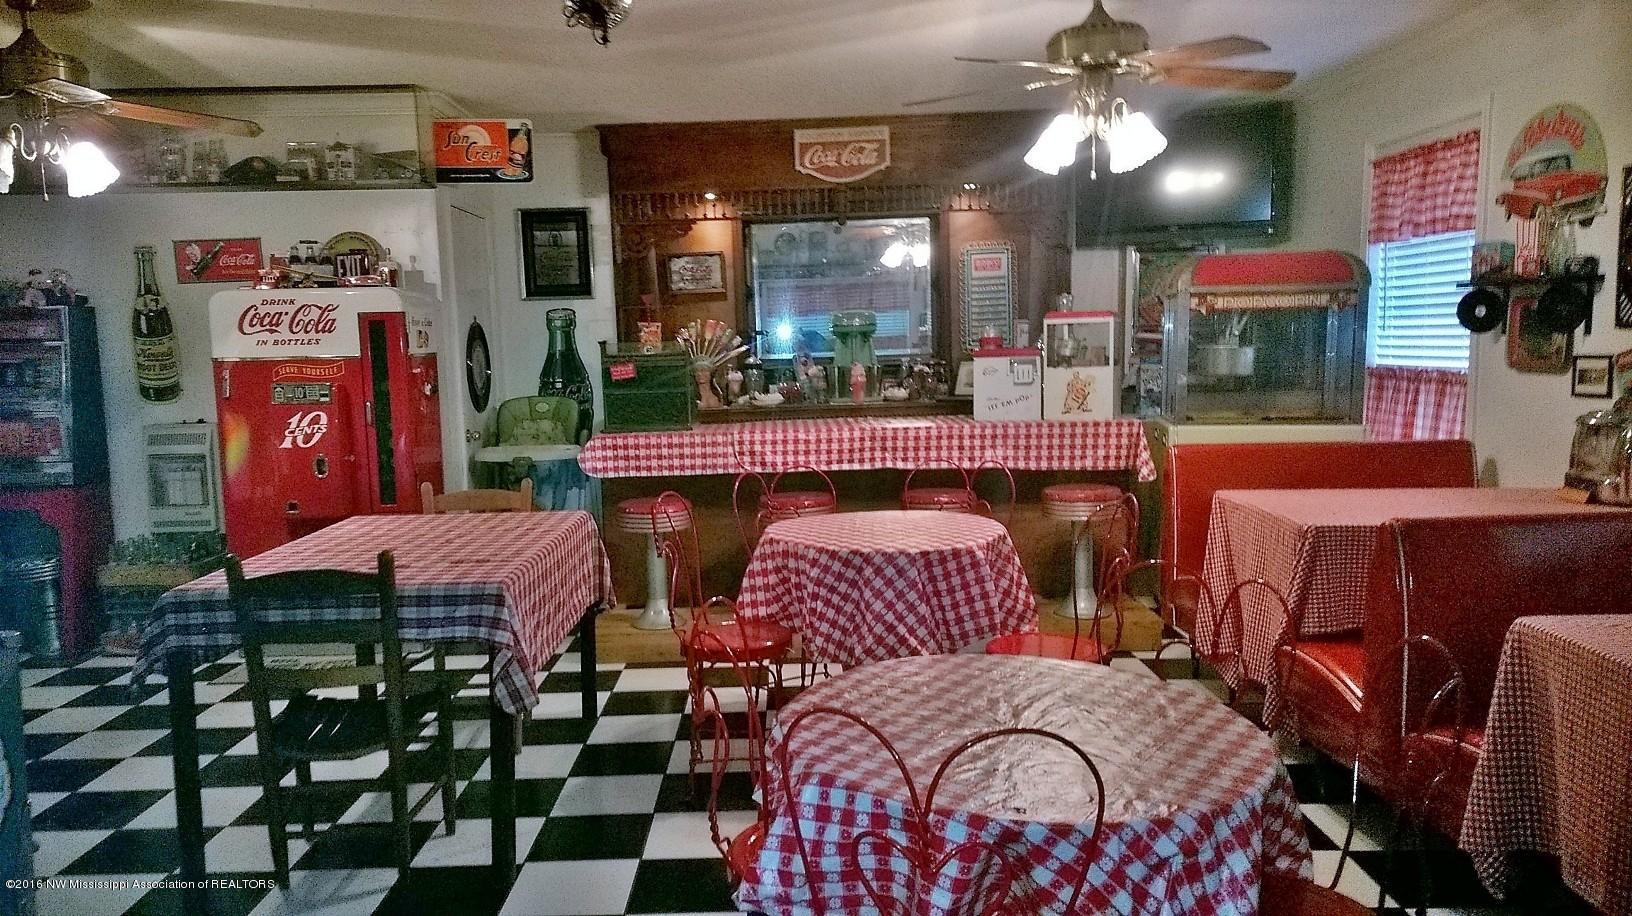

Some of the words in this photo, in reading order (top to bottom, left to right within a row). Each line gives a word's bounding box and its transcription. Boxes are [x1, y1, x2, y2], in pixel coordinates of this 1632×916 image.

[260, 298, 297, 306] DRINK
[237, 303, 340, 336] Coca-Cola
[271, 338, 322, 346] BOTTLES
[278, 366, 298, 376] SERVE
[302, 366, 339, 376] YOURSELF
[278, 411, 328, 449] 10
[284, 424, 328, 437] CENTS
